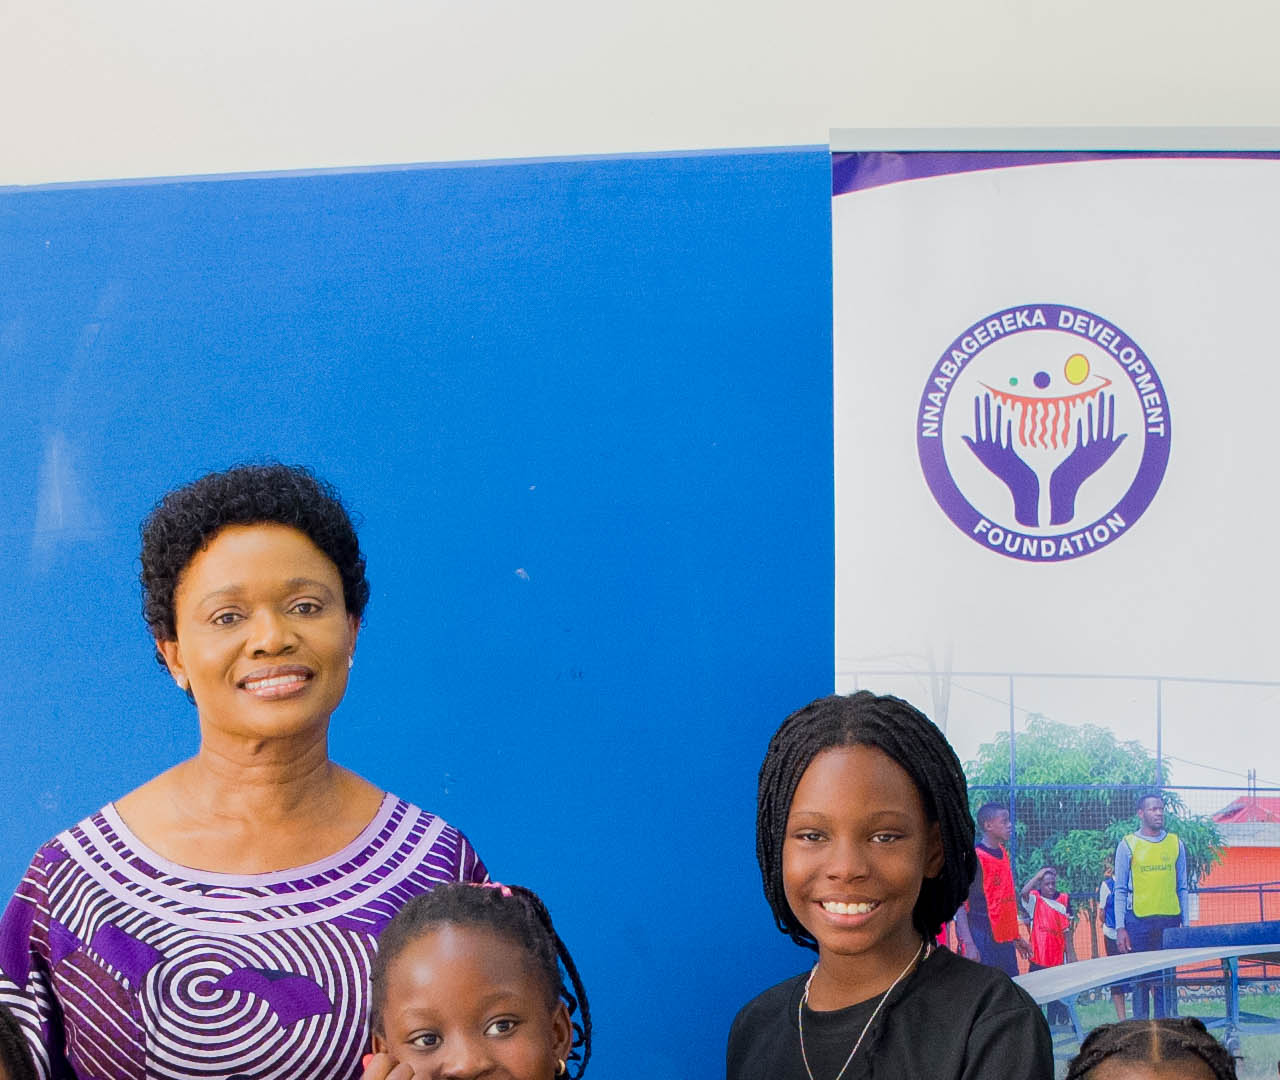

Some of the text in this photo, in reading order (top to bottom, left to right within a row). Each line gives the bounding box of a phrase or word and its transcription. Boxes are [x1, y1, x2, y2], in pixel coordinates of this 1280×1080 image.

[922, 308, 1165, 438] NNAABAGEREKA DEVELOPMENT
[972, 512, 1127, 558] FOUNDATION
